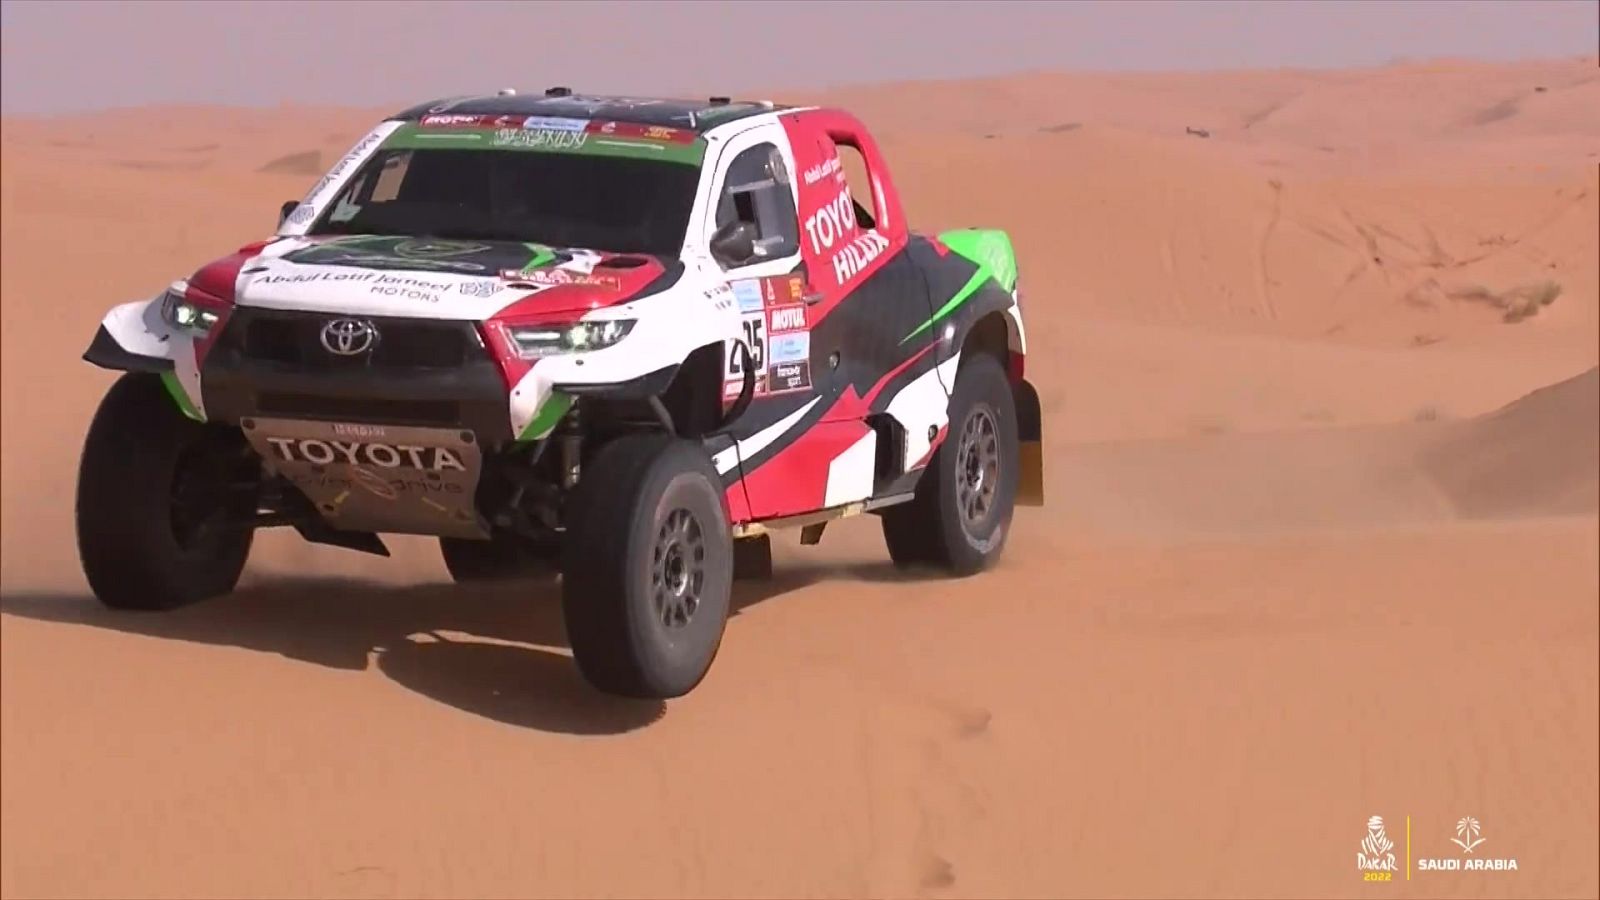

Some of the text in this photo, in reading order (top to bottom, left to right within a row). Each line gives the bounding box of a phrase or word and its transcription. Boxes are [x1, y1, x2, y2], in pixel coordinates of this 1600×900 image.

[805, 185, 853, 255] TOYO
[832, 229, 889, 285] HILUX
[254, 272, 453, 291] Abdul Latif Jameel
[370, 286, 440, 303] MOTORS
[771, 307, 806, 331] MOTUL
[267, 437, 466, 472] TOYOTA
